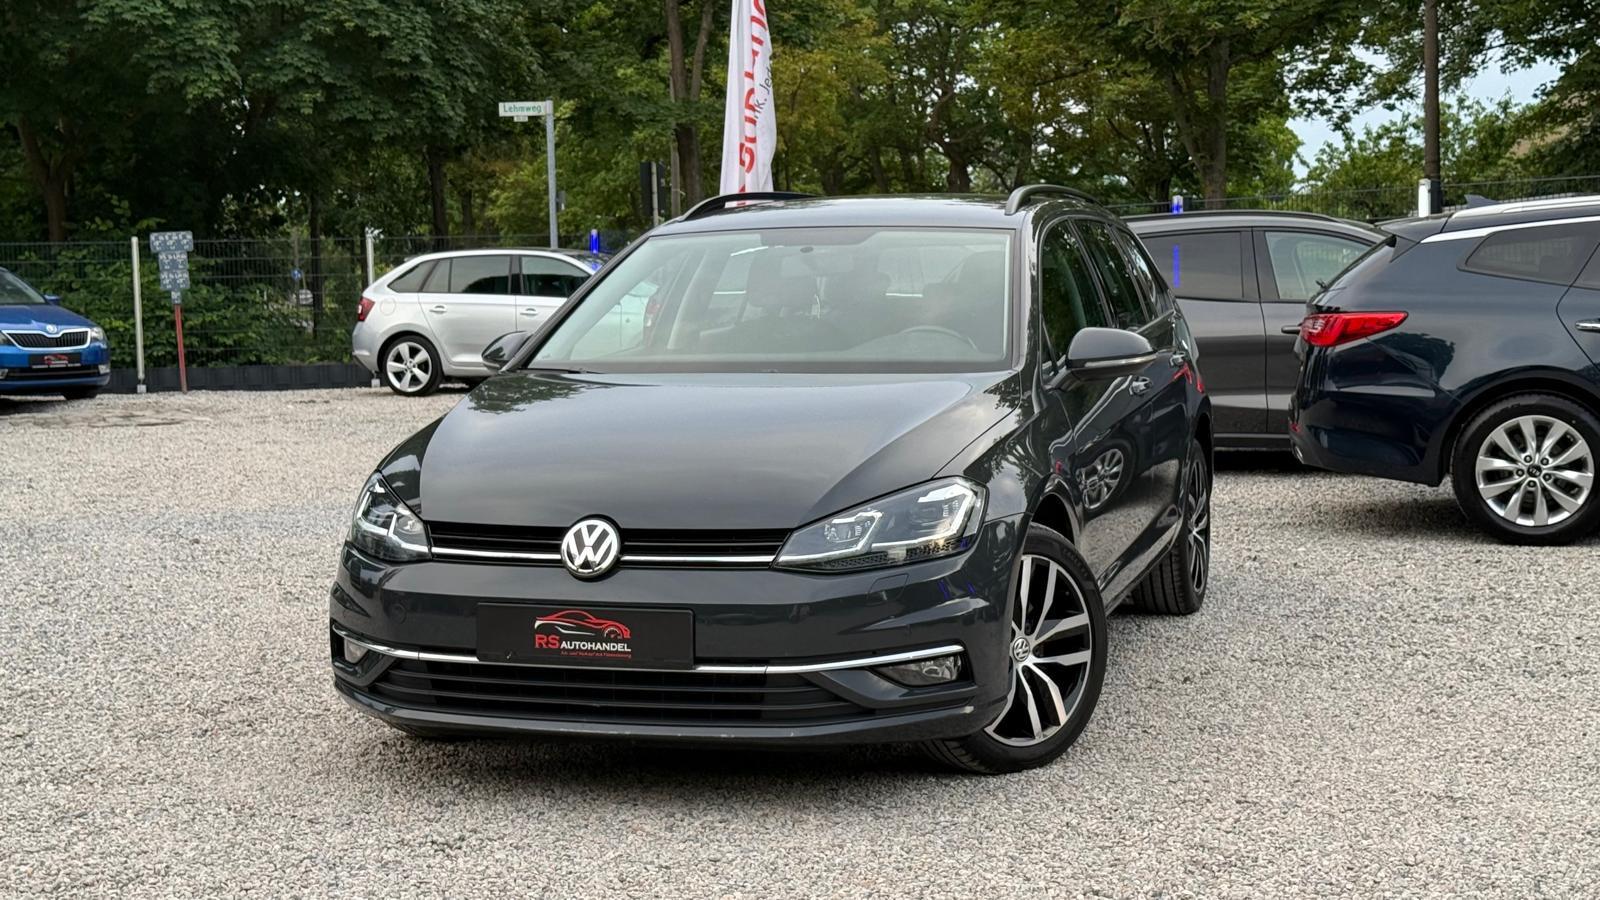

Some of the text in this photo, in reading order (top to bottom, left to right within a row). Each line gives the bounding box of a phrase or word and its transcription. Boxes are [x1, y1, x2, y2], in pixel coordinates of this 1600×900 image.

[503, 104, 542, 113] Lehmweg
[563, 520, 618, 574] VW
[535, 634, 631, 652] RS AUTOHANDEL
